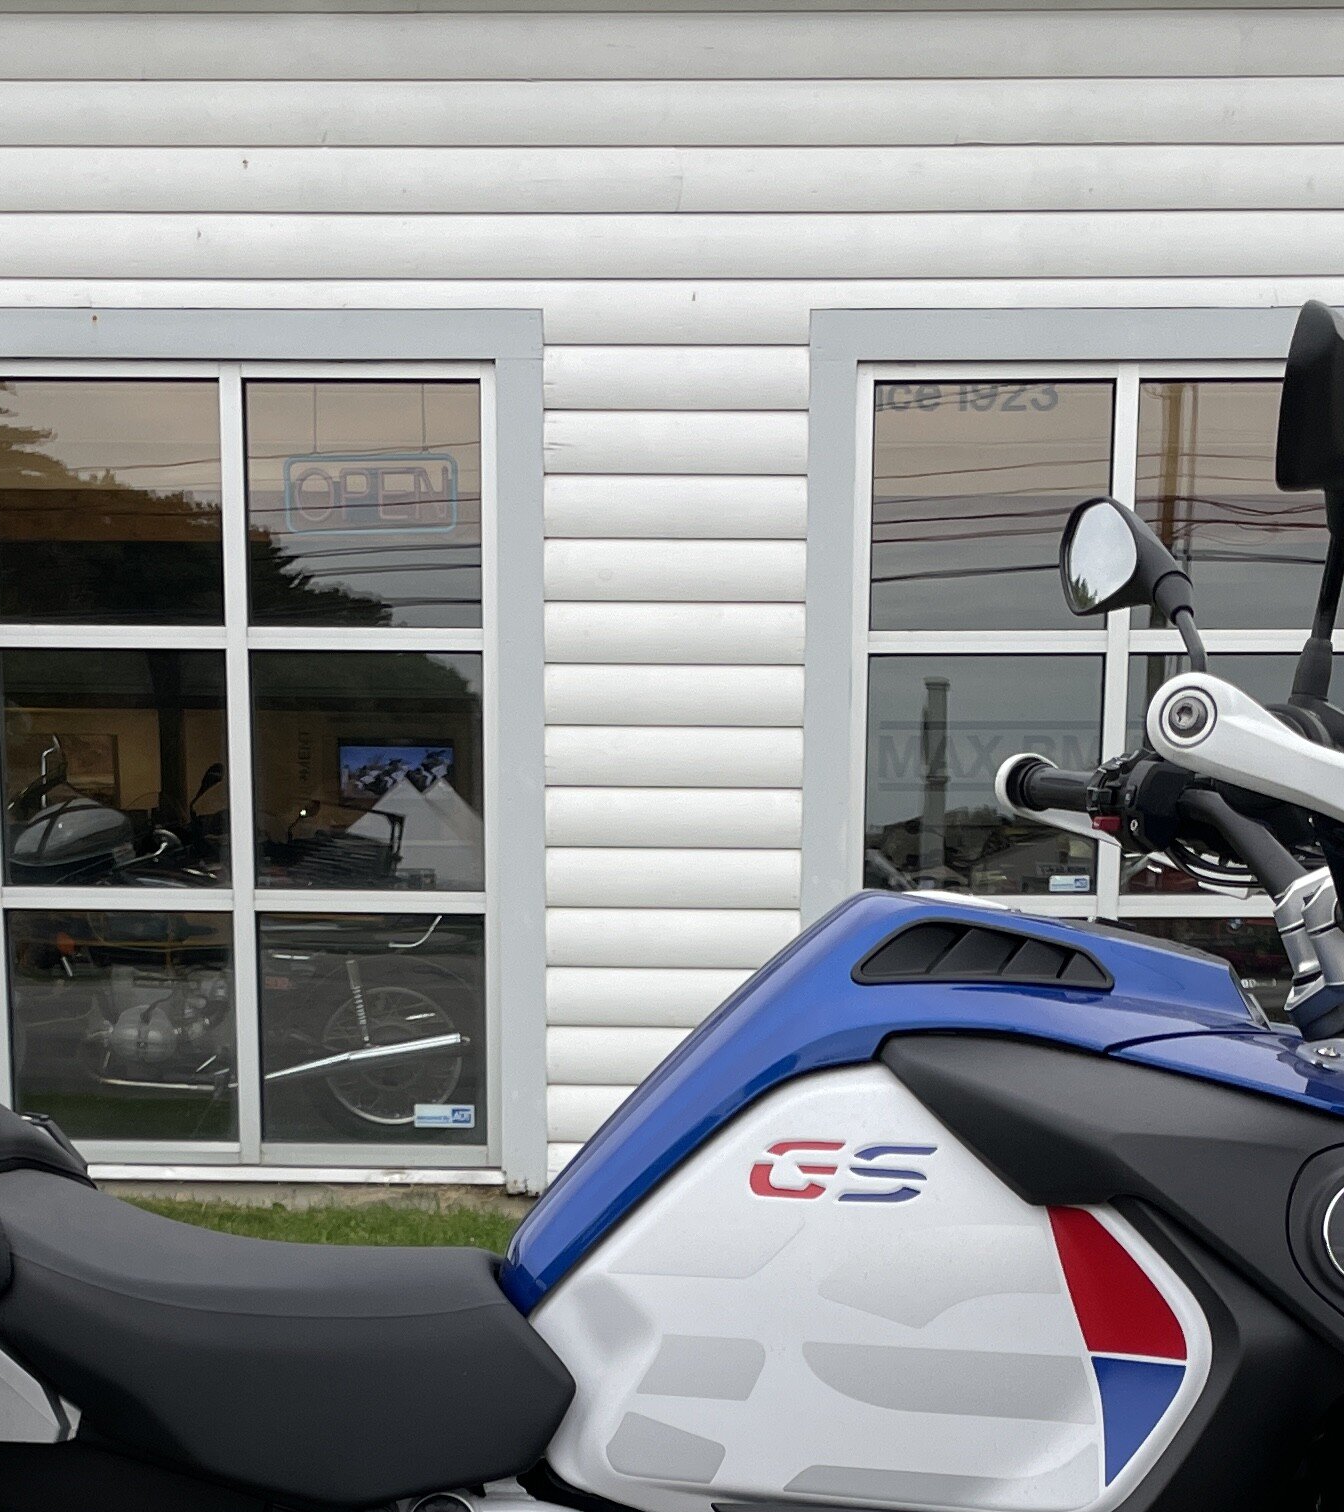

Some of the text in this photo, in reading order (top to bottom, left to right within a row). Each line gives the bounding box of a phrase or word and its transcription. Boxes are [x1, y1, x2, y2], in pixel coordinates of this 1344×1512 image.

[296, 465, 448, 522] OPEN
[878, 735, 1002, 778] MAX
[748, 1139, 940, 1203] GS
